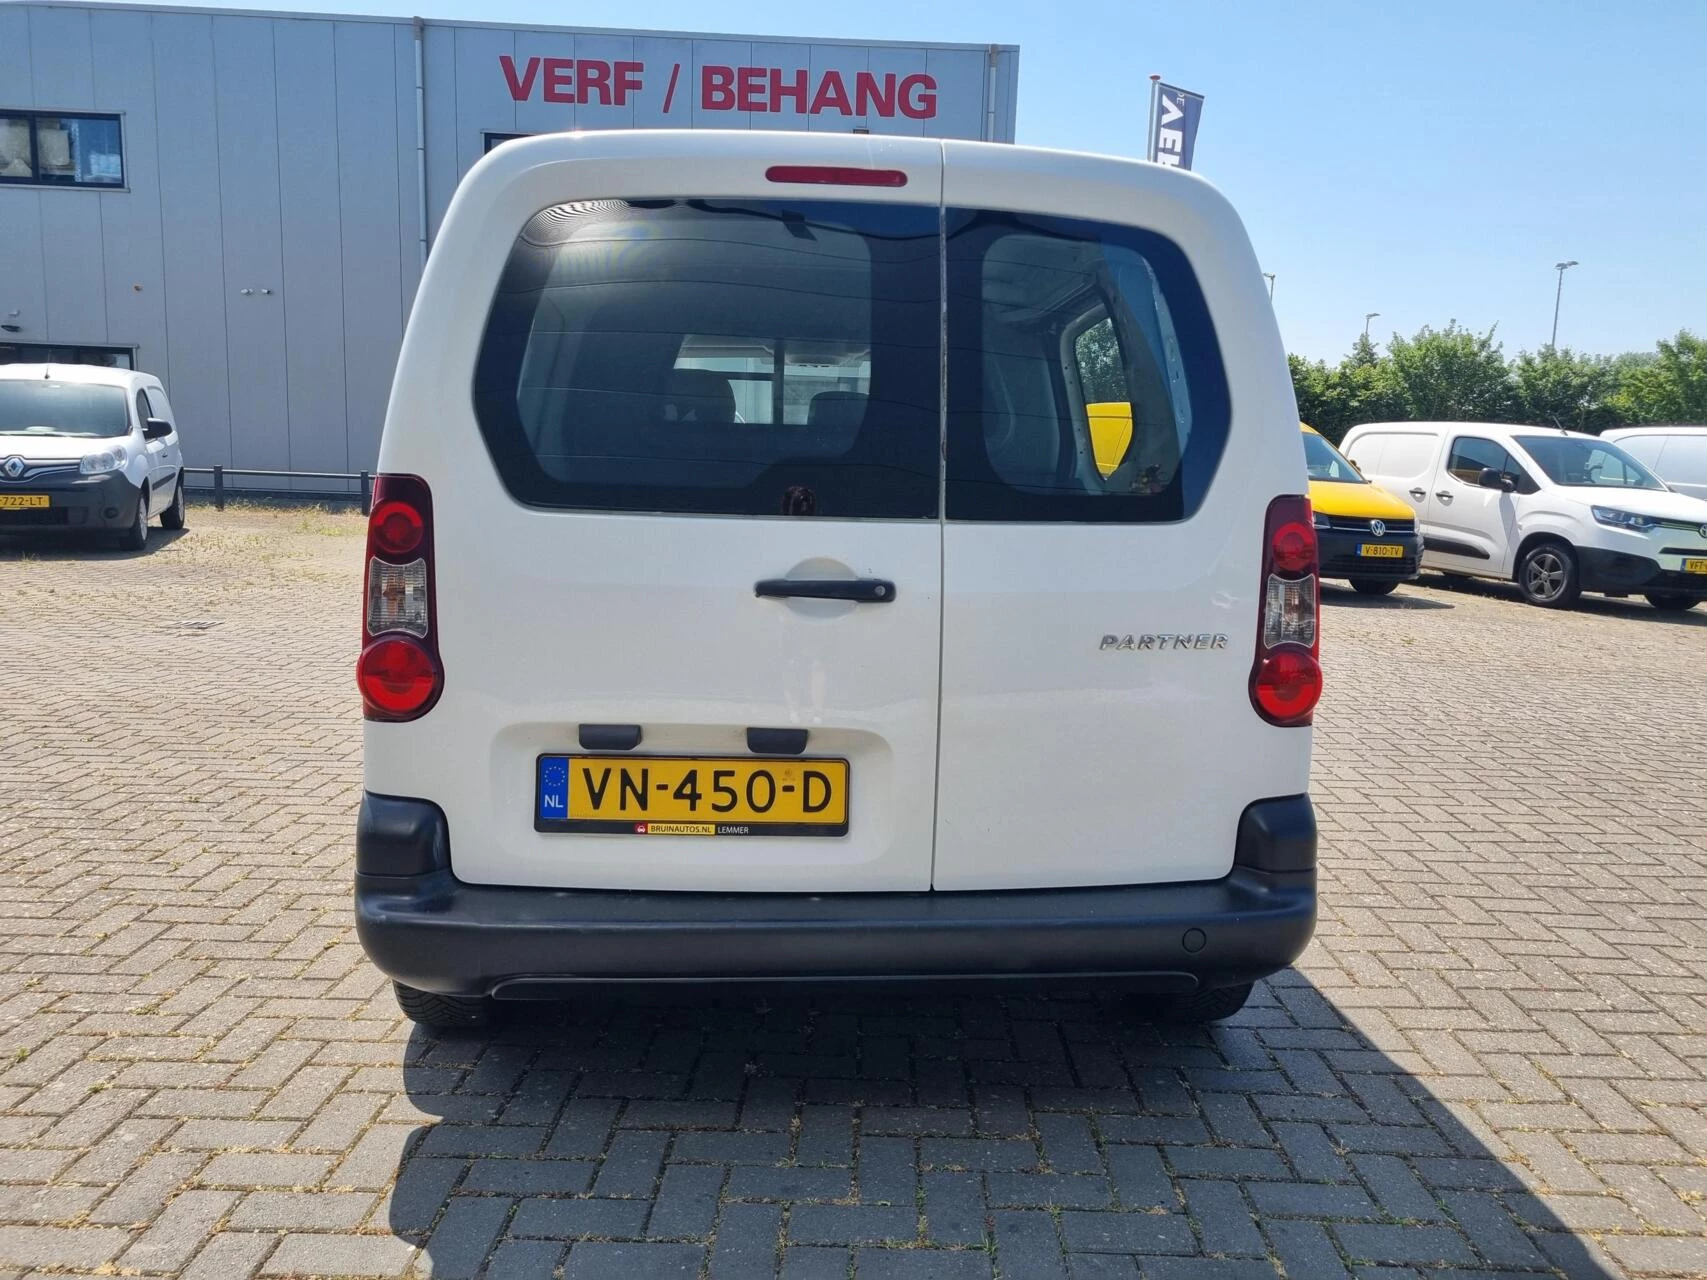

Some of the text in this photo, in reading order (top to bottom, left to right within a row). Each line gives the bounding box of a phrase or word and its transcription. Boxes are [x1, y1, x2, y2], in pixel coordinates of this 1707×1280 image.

[499, 56, 937, 119] VERF / BEHANG
[1100, 634, 1229, 650] PARTNER
[582, 767, 832, 814] VN-450-D
[544, 795, 564, 808] NL
[651, 824, 749, 835] BRUINAUTOS.NL LEMMER
